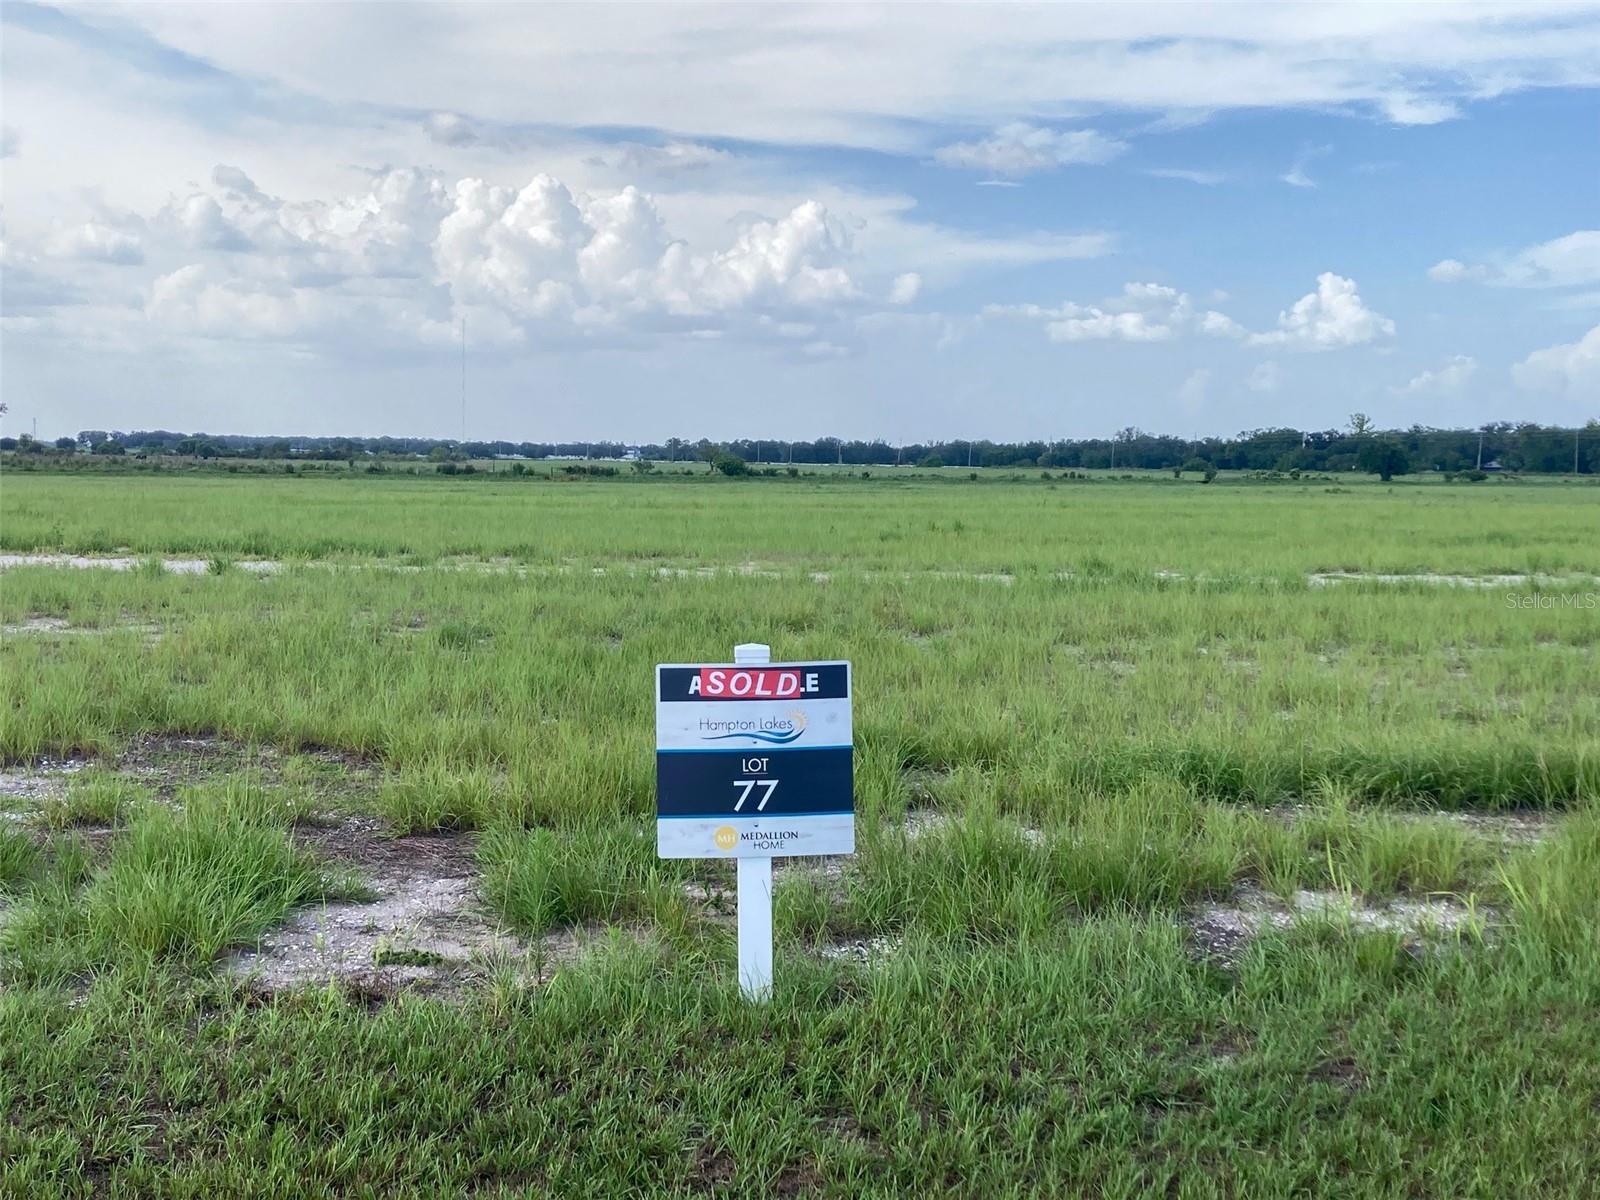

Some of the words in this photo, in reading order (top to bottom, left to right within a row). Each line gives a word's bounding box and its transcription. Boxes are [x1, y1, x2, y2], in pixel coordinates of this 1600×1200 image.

[706, 671, 798, 695] SOLD
[700, 718, 755, 733] Hampton
[760, 716, 793, 730] Lakes
[742, 758, 769, 773] LOT
[733, 779, 779, 812] 77
[718, 834, 736, 843] MH
[740, 831, 799, 841] MEDALLION
[753, 841, 785, 850] HOME
